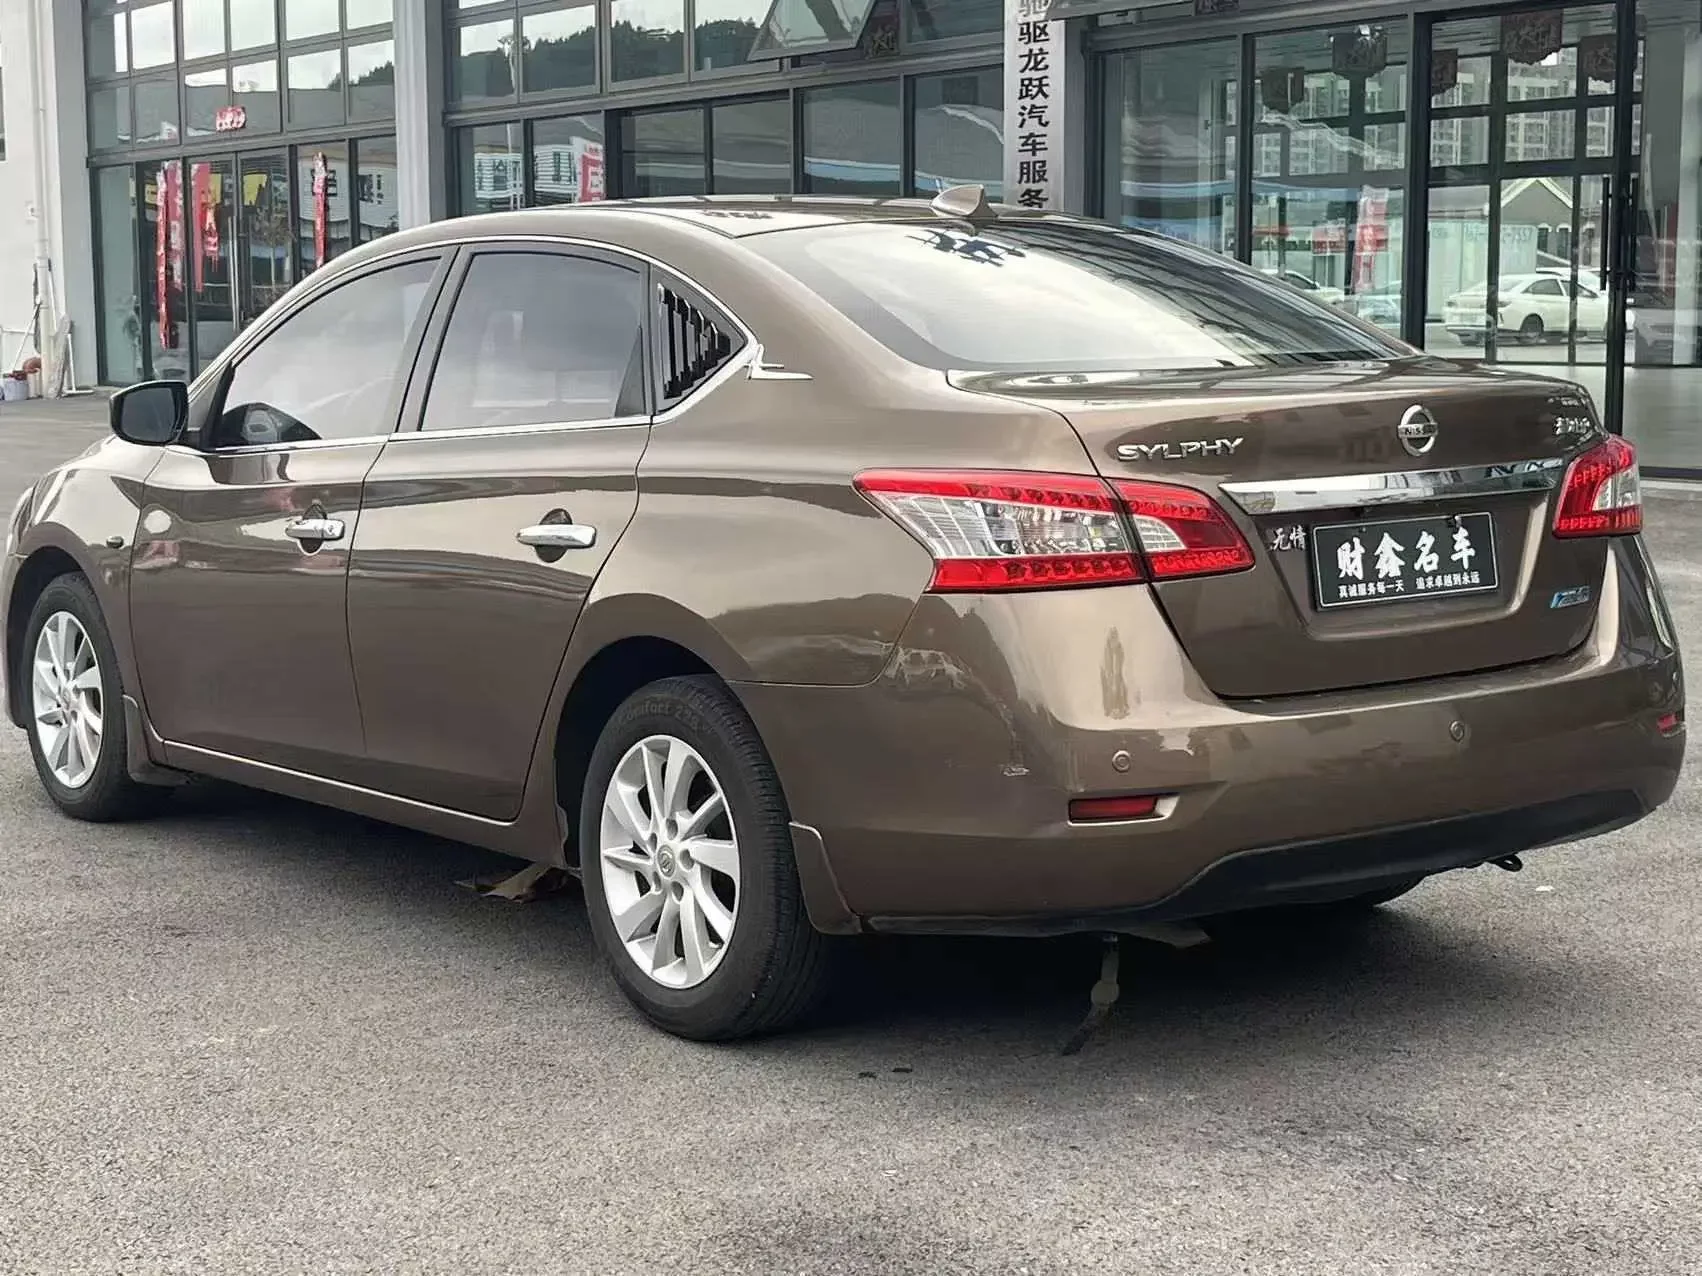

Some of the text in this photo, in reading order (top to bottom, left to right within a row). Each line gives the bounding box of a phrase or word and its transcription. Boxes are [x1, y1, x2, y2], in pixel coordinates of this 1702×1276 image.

[1117, 437, 1244, 461] SYLPHY
[1336, 526, 1476, 580] 财鑫名车
